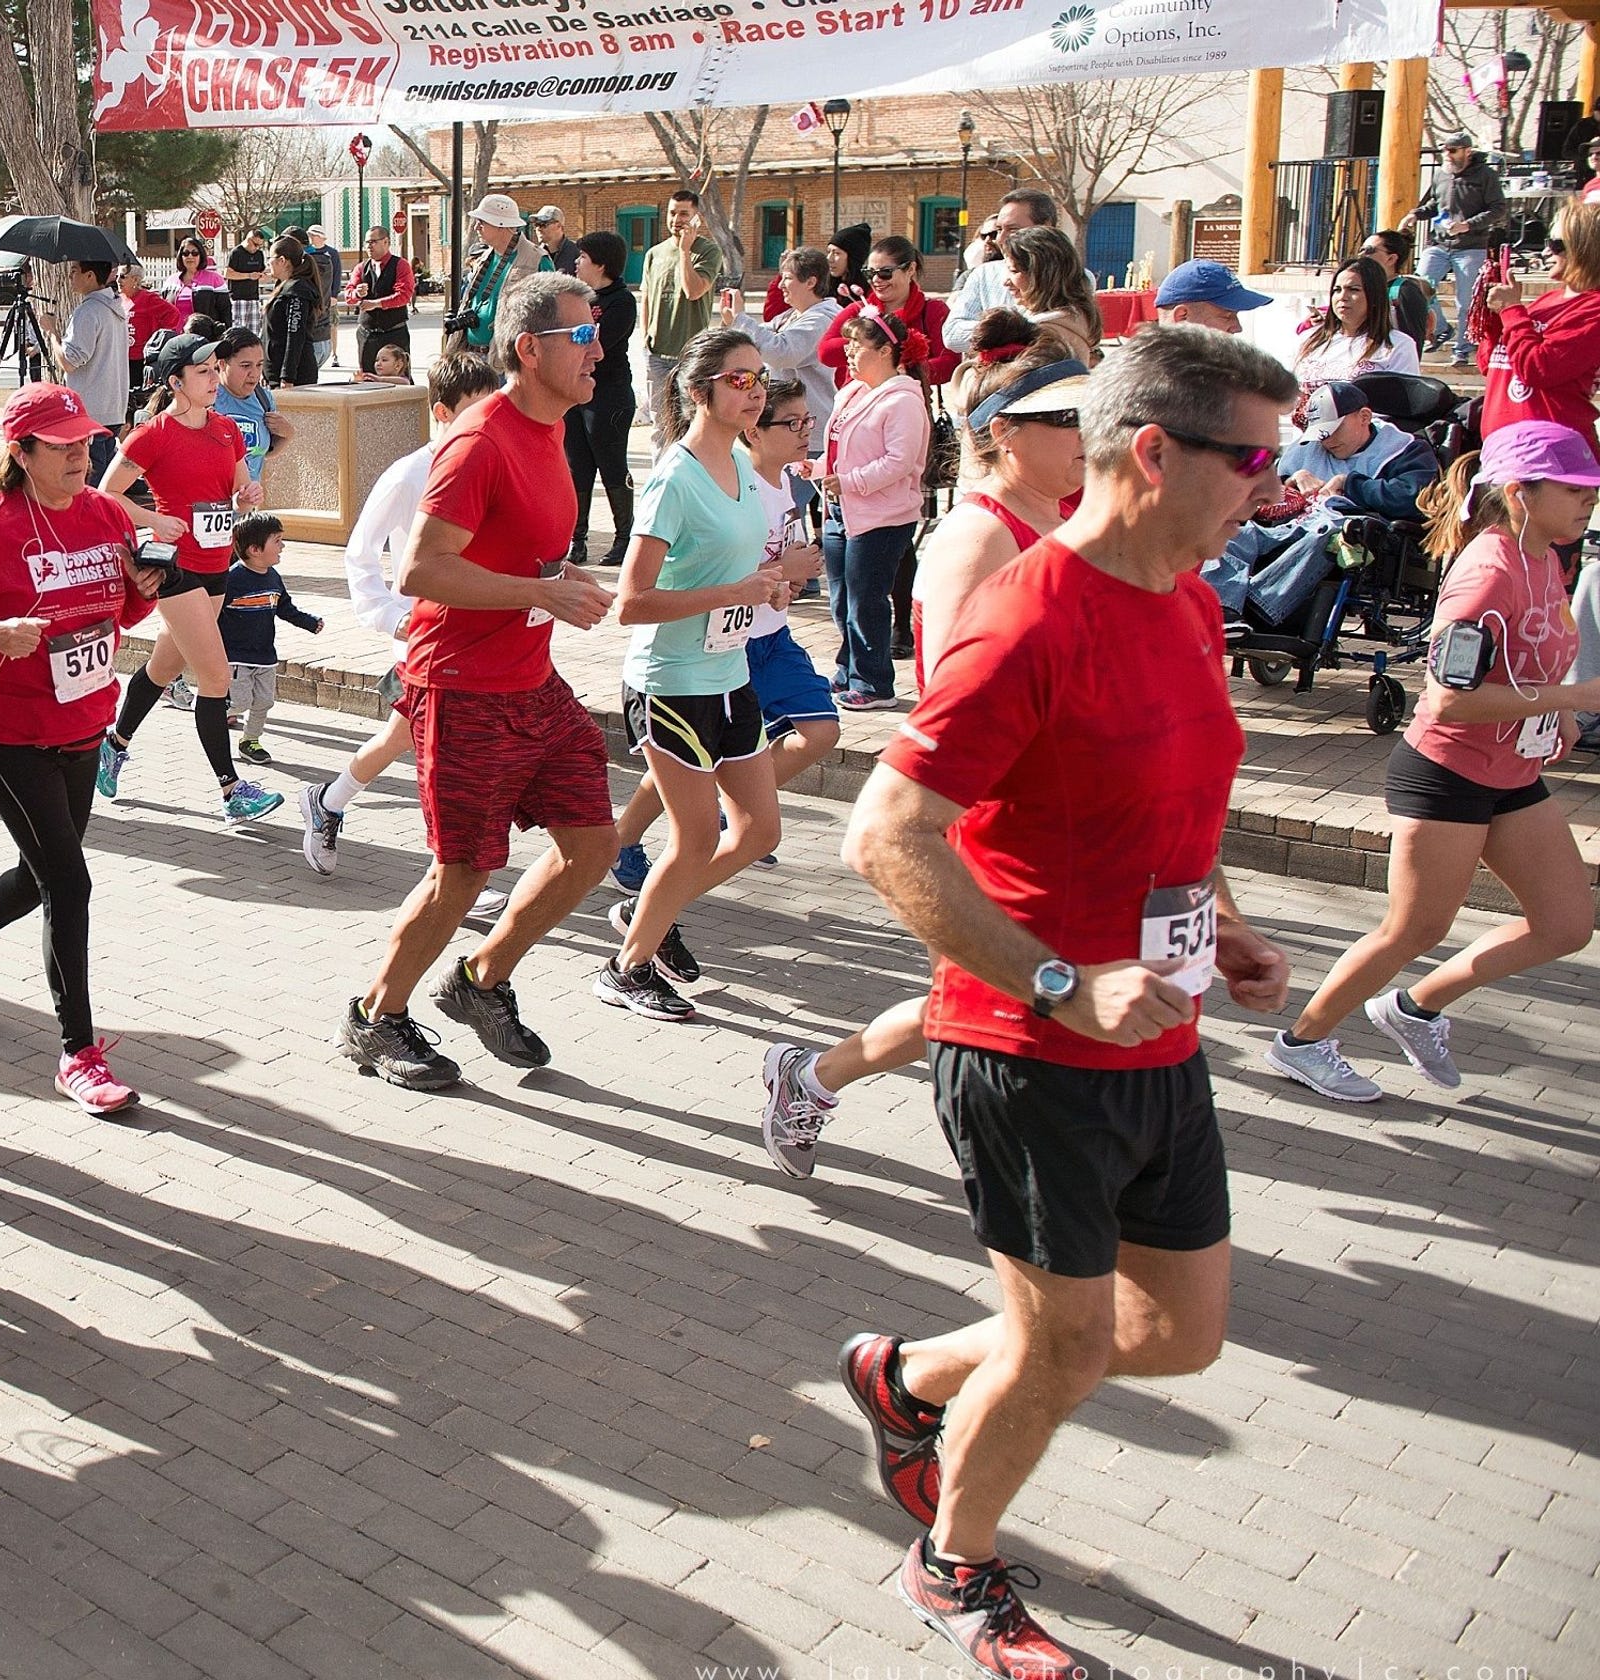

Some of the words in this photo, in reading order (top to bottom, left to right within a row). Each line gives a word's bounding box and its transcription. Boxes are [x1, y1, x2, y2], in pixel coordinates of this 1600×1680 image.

[196, 0, 384, 47] CUPID'S
[403, 24, 466, 41] 2114
[472, 16, 542, 38] Calle
[554, 16, 587, 33] De
[597, 3, 734, 29] Santiago
[429, 38, 593, 70] Registration
[600, 32, 620, 55] 8
[628, 30, 675, 52] am
[721, 18, 805, 44] Race
[817, 7, 905, 36] Start
[920, 0, 960, 23] 10
[970, 0, 1023, 16] am
[1104, 26, 1181, 48] Options,
[1187, 21, 1222, 38] Inc.
[1090, 58, 1114, 70] People
[1115, 57, 1134, 67] with
[1136, 53, 1181, 66] Disabilities
[1182, 52, 1202, 62] since
[1205, 50, 1227, 61] 1989
[186, 57, 313, 113] CHASE
[318, 56, 393, 109] 5K
[405, 69, 679, 102] cupidschase@comop.org
[200, 217, 220, 230] STOP
[203, 513, 232, 533] 705
[64, 545, 114, 569] CUPID'S
[66, 566, 103, 585] CHASE
[102, 562, 117, 578] 5K
[722, 605, 754, 634] 709
[66, 640, 109, 678] 570
[1167, 906, 1216, 959] 531
